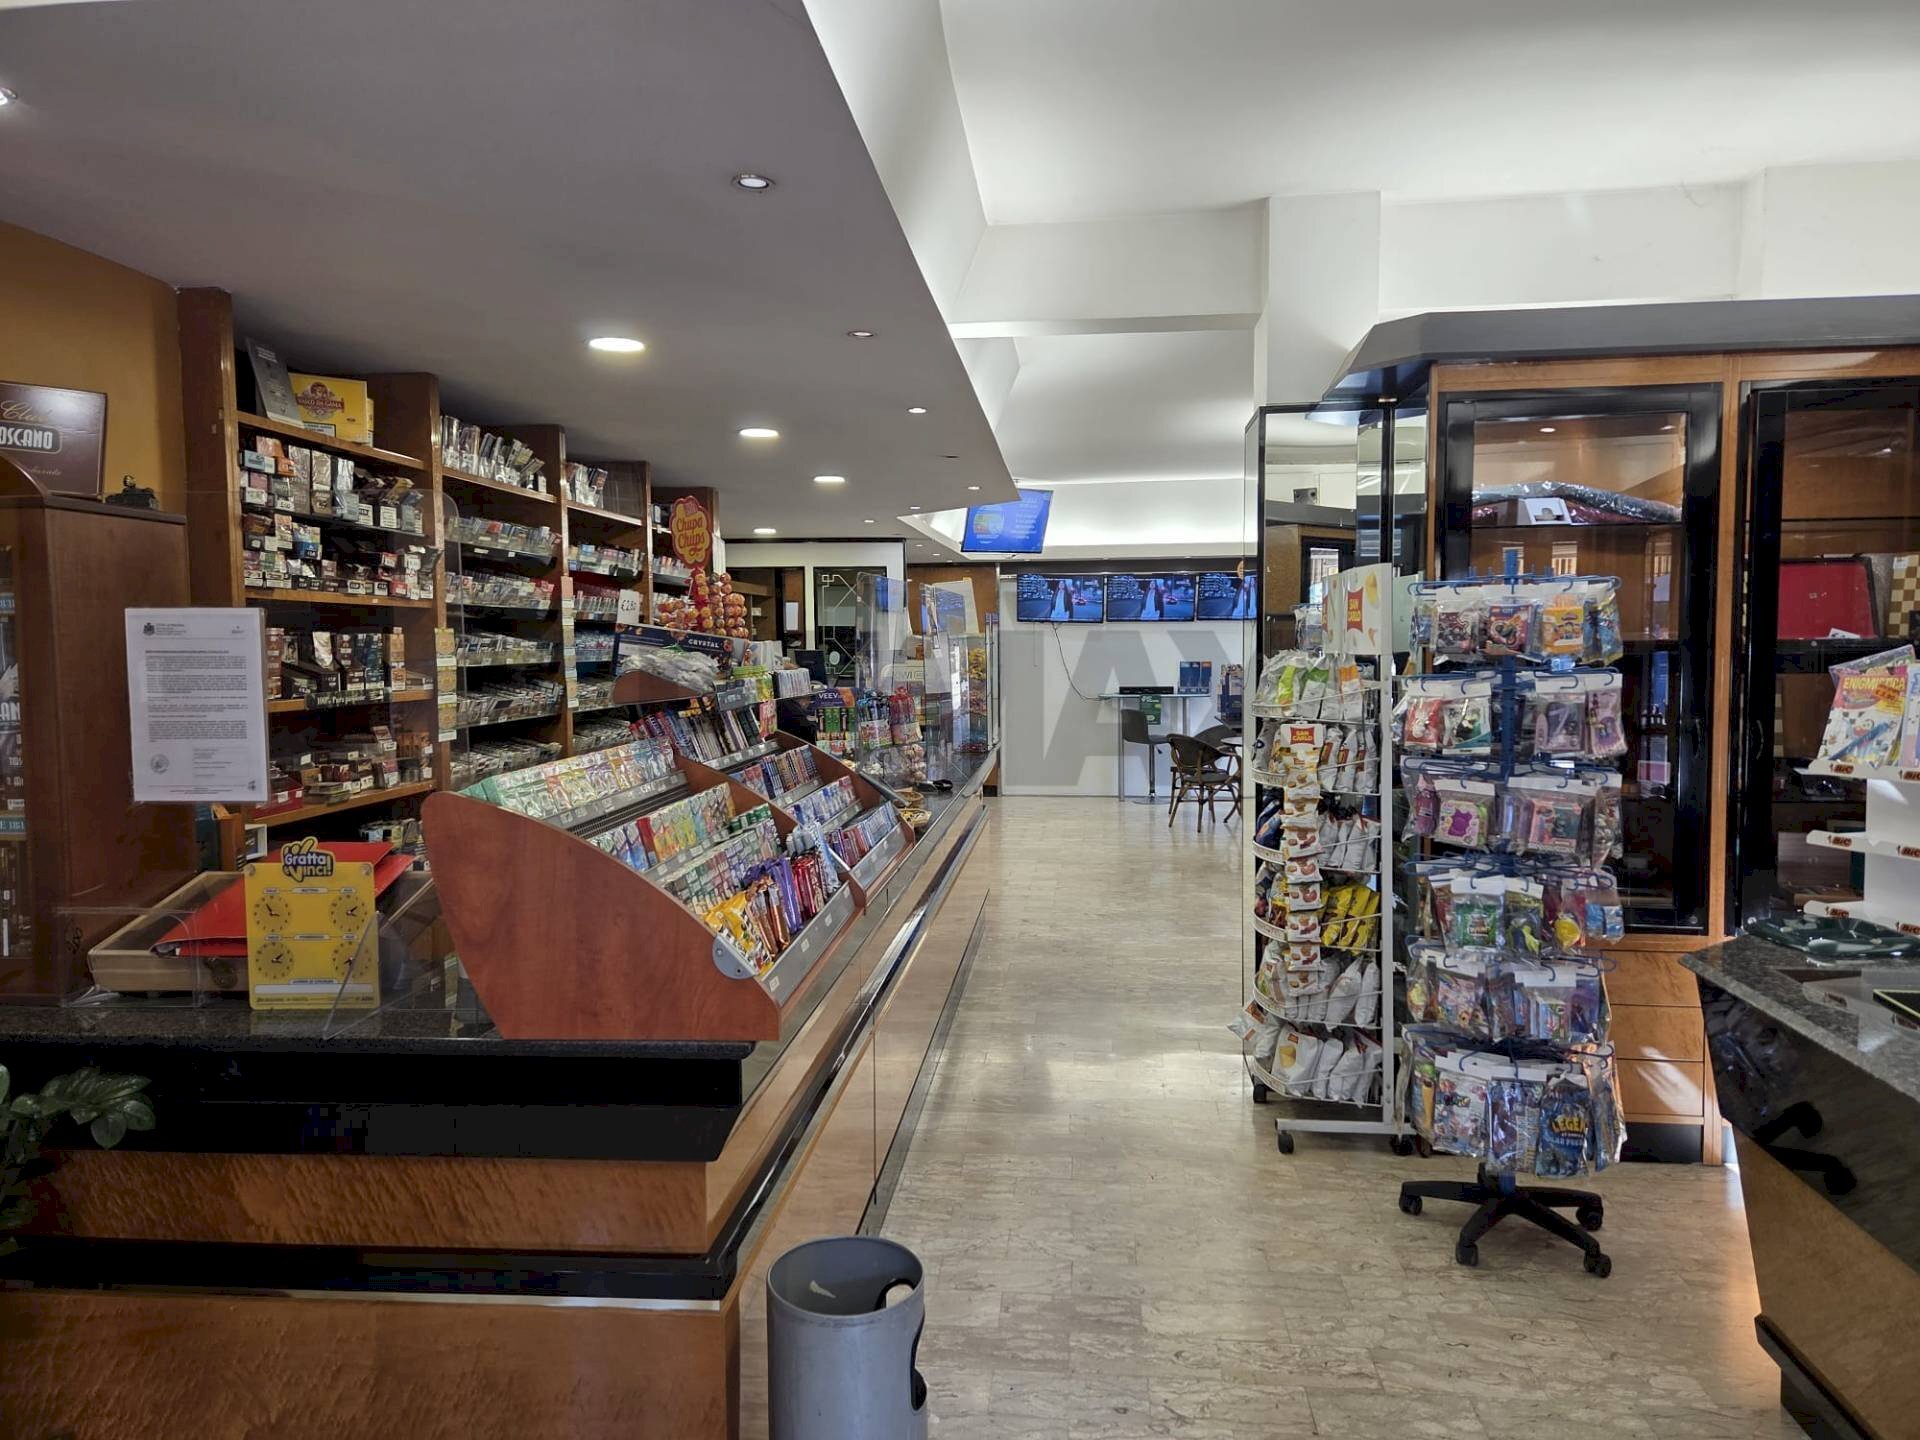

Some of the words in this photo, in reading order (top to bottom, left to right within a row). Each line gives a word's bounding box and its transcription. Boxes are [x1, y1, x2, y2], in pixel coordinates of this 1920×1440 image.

[676, 516, 703, 534] Chupa
[678, 530, 706, 550] Chups
[687, 637, 720, 650] CRYSTAL
[1832, 836, 1852, 847] BIC
[284, 852, 327, 866] Gratta
[1829, 908, 1849, 918] BIC
